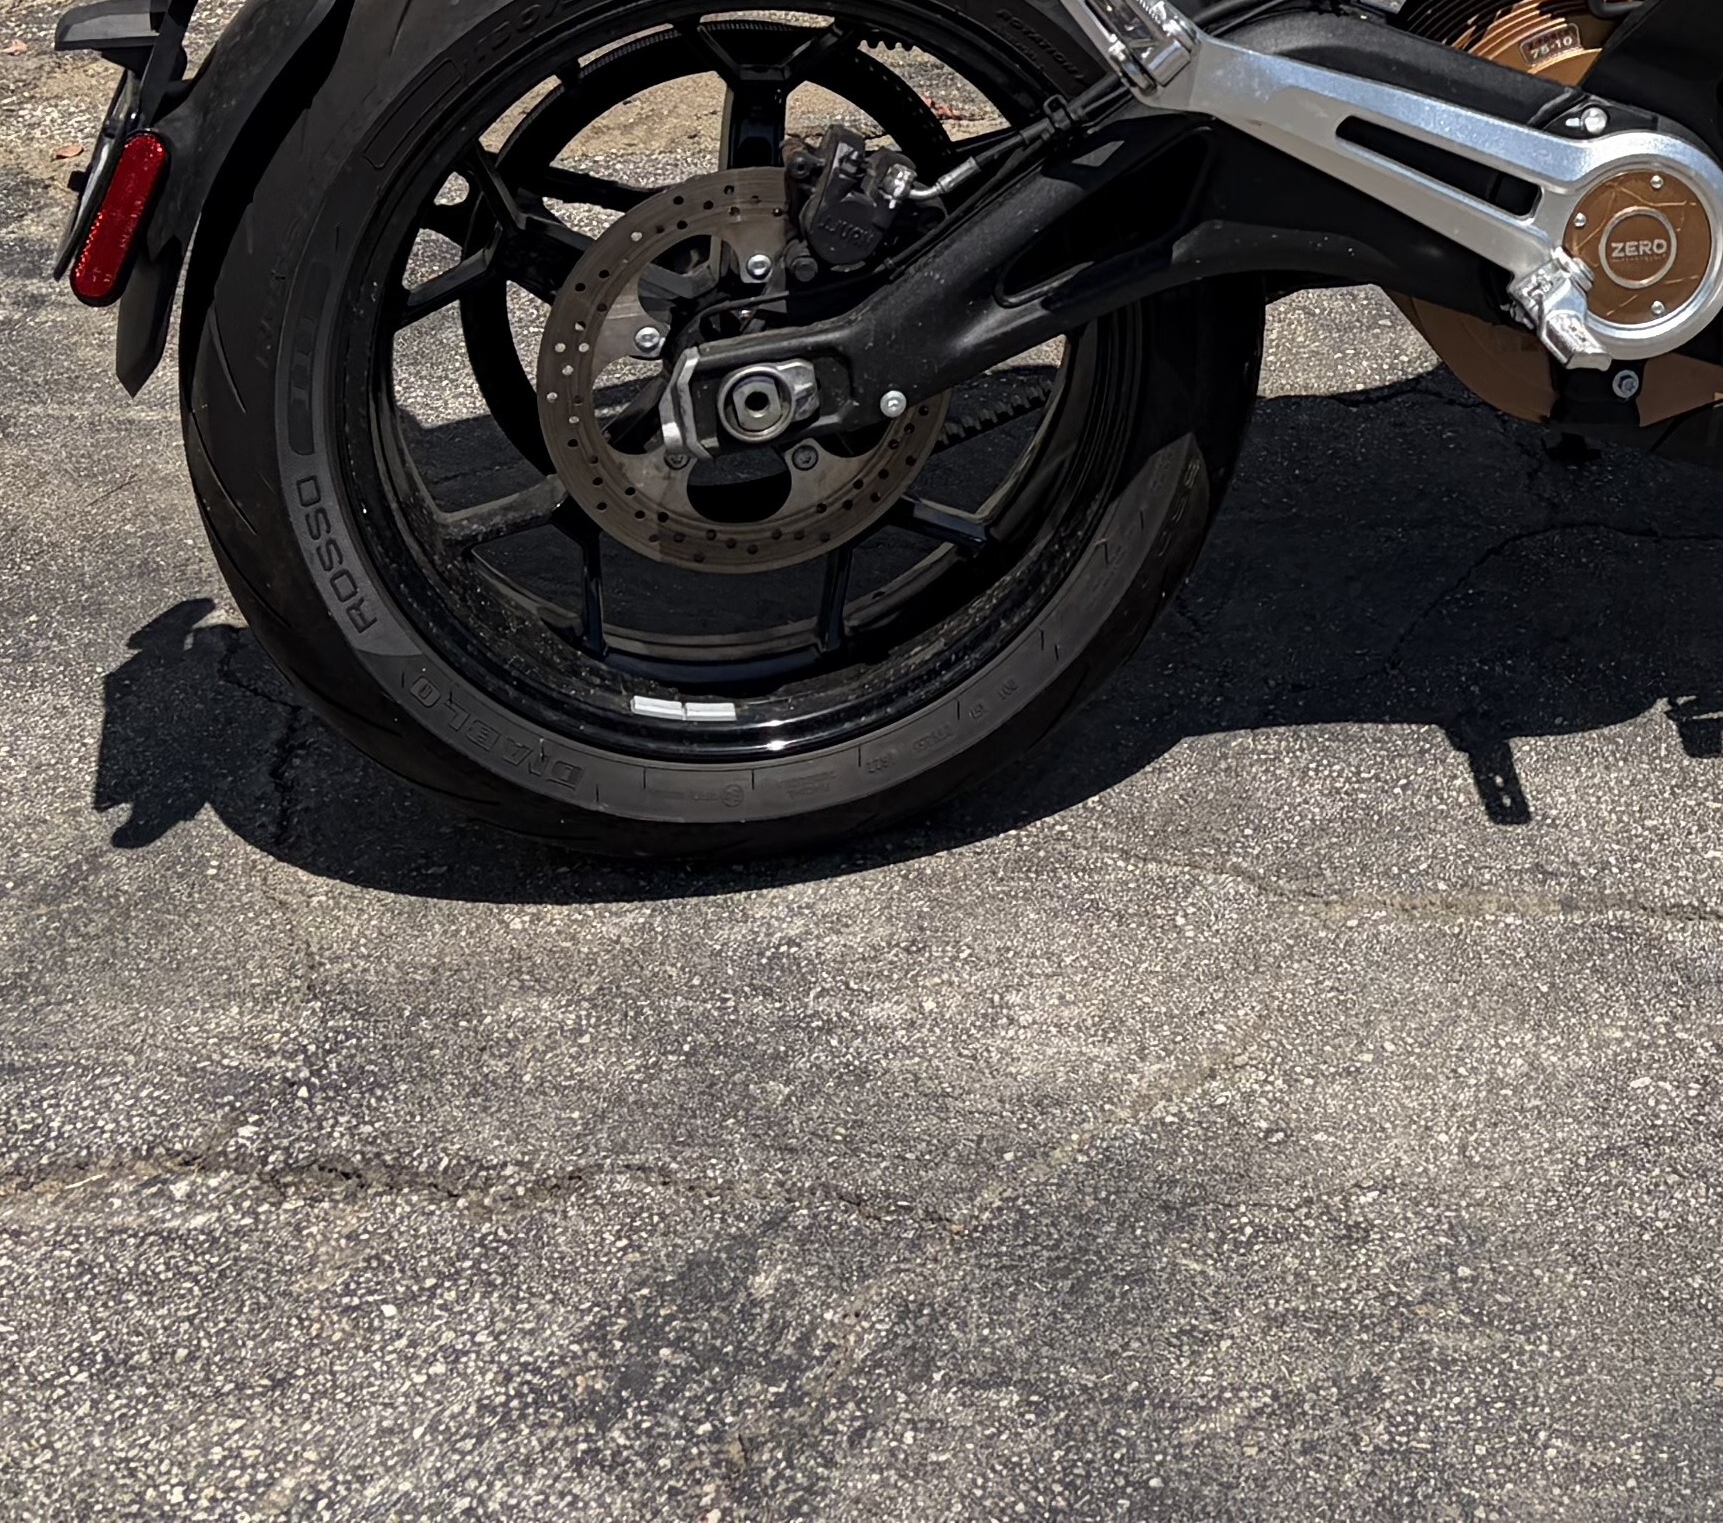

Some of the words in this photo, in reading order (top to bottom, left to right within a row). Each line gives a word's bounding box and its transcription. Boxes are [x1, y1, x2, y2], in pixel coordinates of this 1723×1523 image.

[1530, 35, 1573, 59] 75-10
[1610, 238, 1668, 258] ZERO
[296, 474, 378, 635] ROSSO
[409, 674, 586, 790] DIABLO
